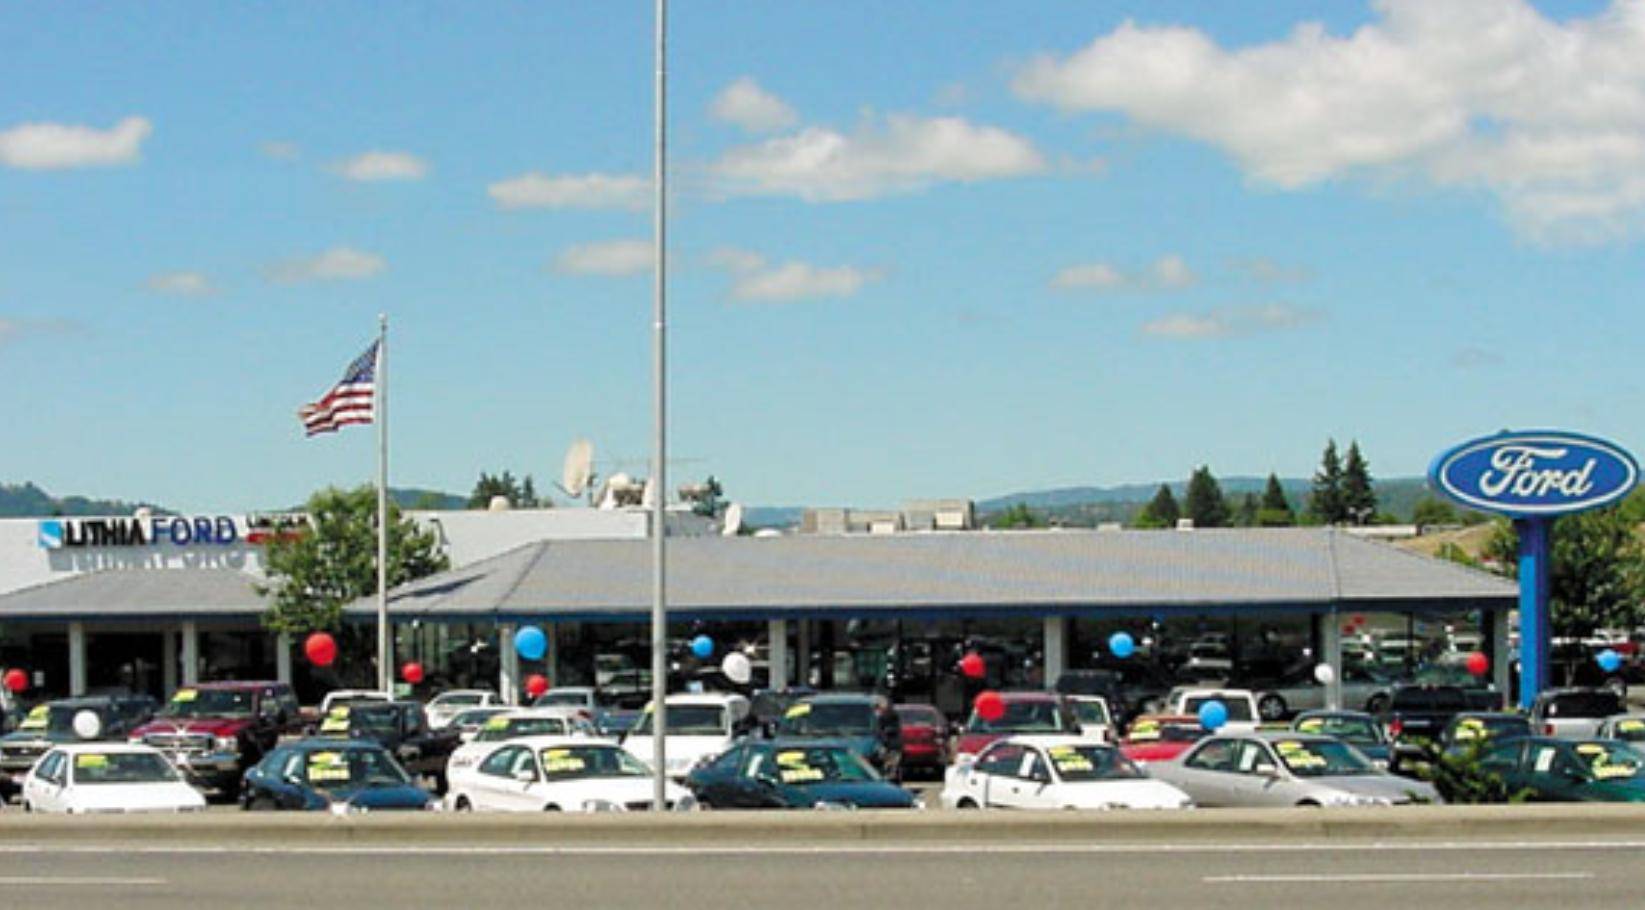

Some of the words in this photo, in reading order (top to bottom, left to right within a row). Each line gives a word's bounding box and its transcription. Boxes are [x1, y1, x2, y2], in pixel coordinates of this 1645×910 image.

[1480, 446, 1596, 497] Ford
[66, 519, 145, 546] LITHIA
[151, 516, 237, 545] FORD
